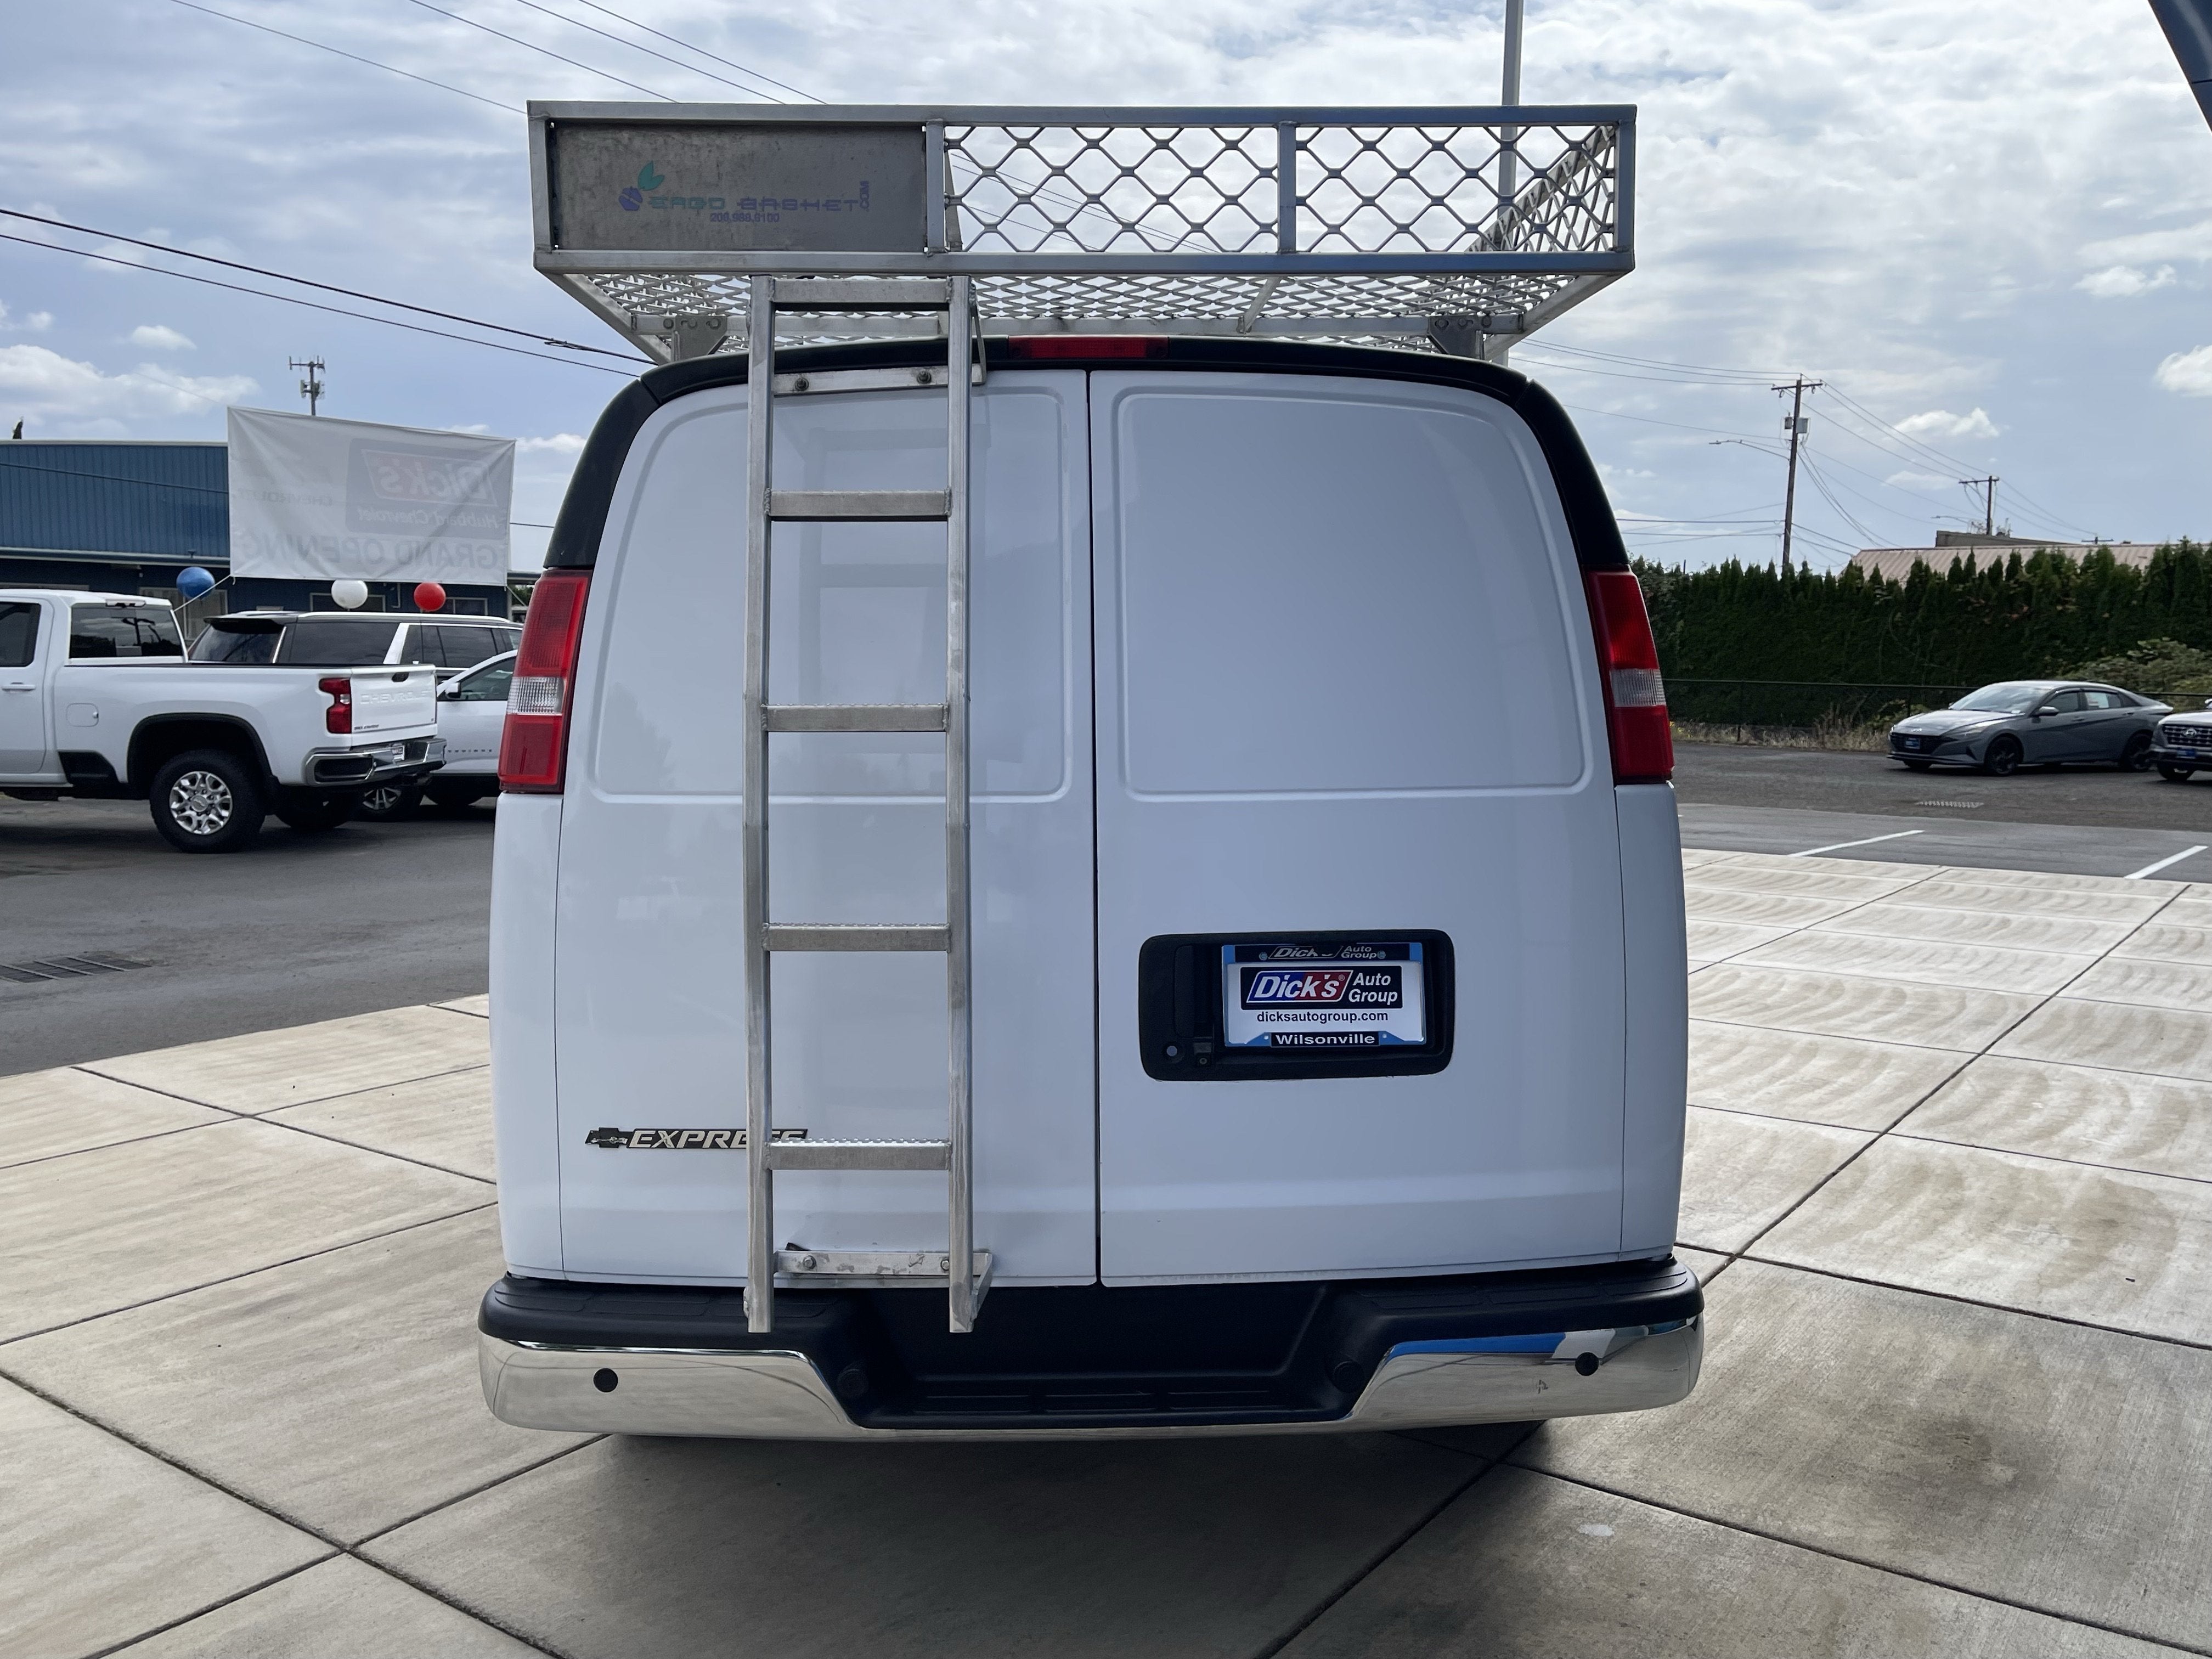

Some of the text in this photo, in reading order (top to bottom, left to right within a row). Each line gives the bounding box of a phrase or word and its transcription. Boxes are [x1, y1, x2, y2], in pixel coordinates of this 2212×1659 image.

[1273, 947, 1334, 958] Dick
[1352, 972, 1391, 986] Auto
[1348, 989, 1398, 1005] Group
[1257, 1011, 1389, 1024] dicksautogroup.com
[1276, 1034, 1375, 1045] Wilsonville
[629, 1130, 804, 1148] EXPRE
